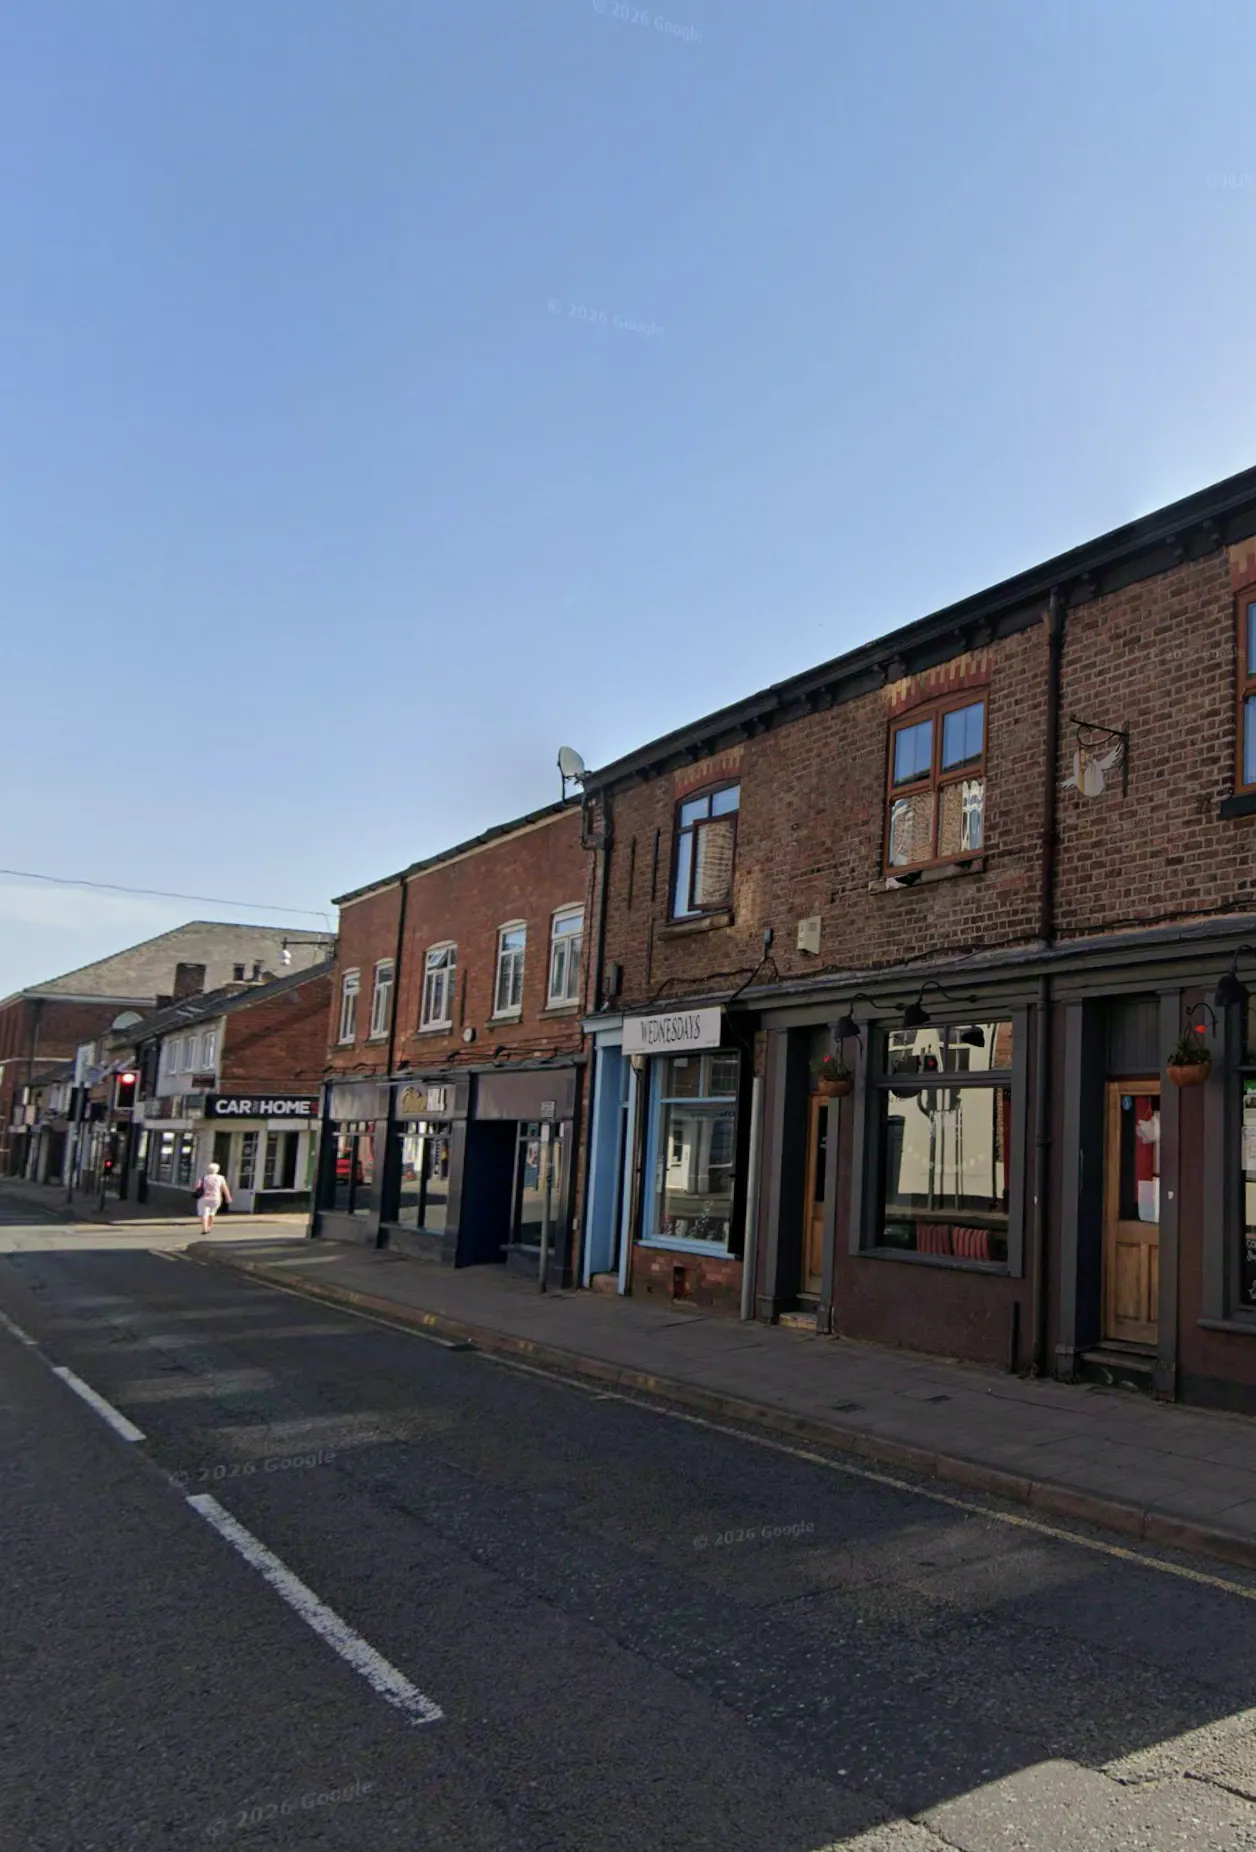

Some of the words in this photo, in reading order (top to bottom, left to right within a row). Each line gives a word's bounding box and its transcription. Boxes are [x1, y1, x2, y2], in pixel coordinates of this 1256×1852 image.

[640, 1014, 701, 1045] WEDNESDAYS
[215, 1099, 252, 1114] CAR
[259, 1100, 312, 1114] HOME
